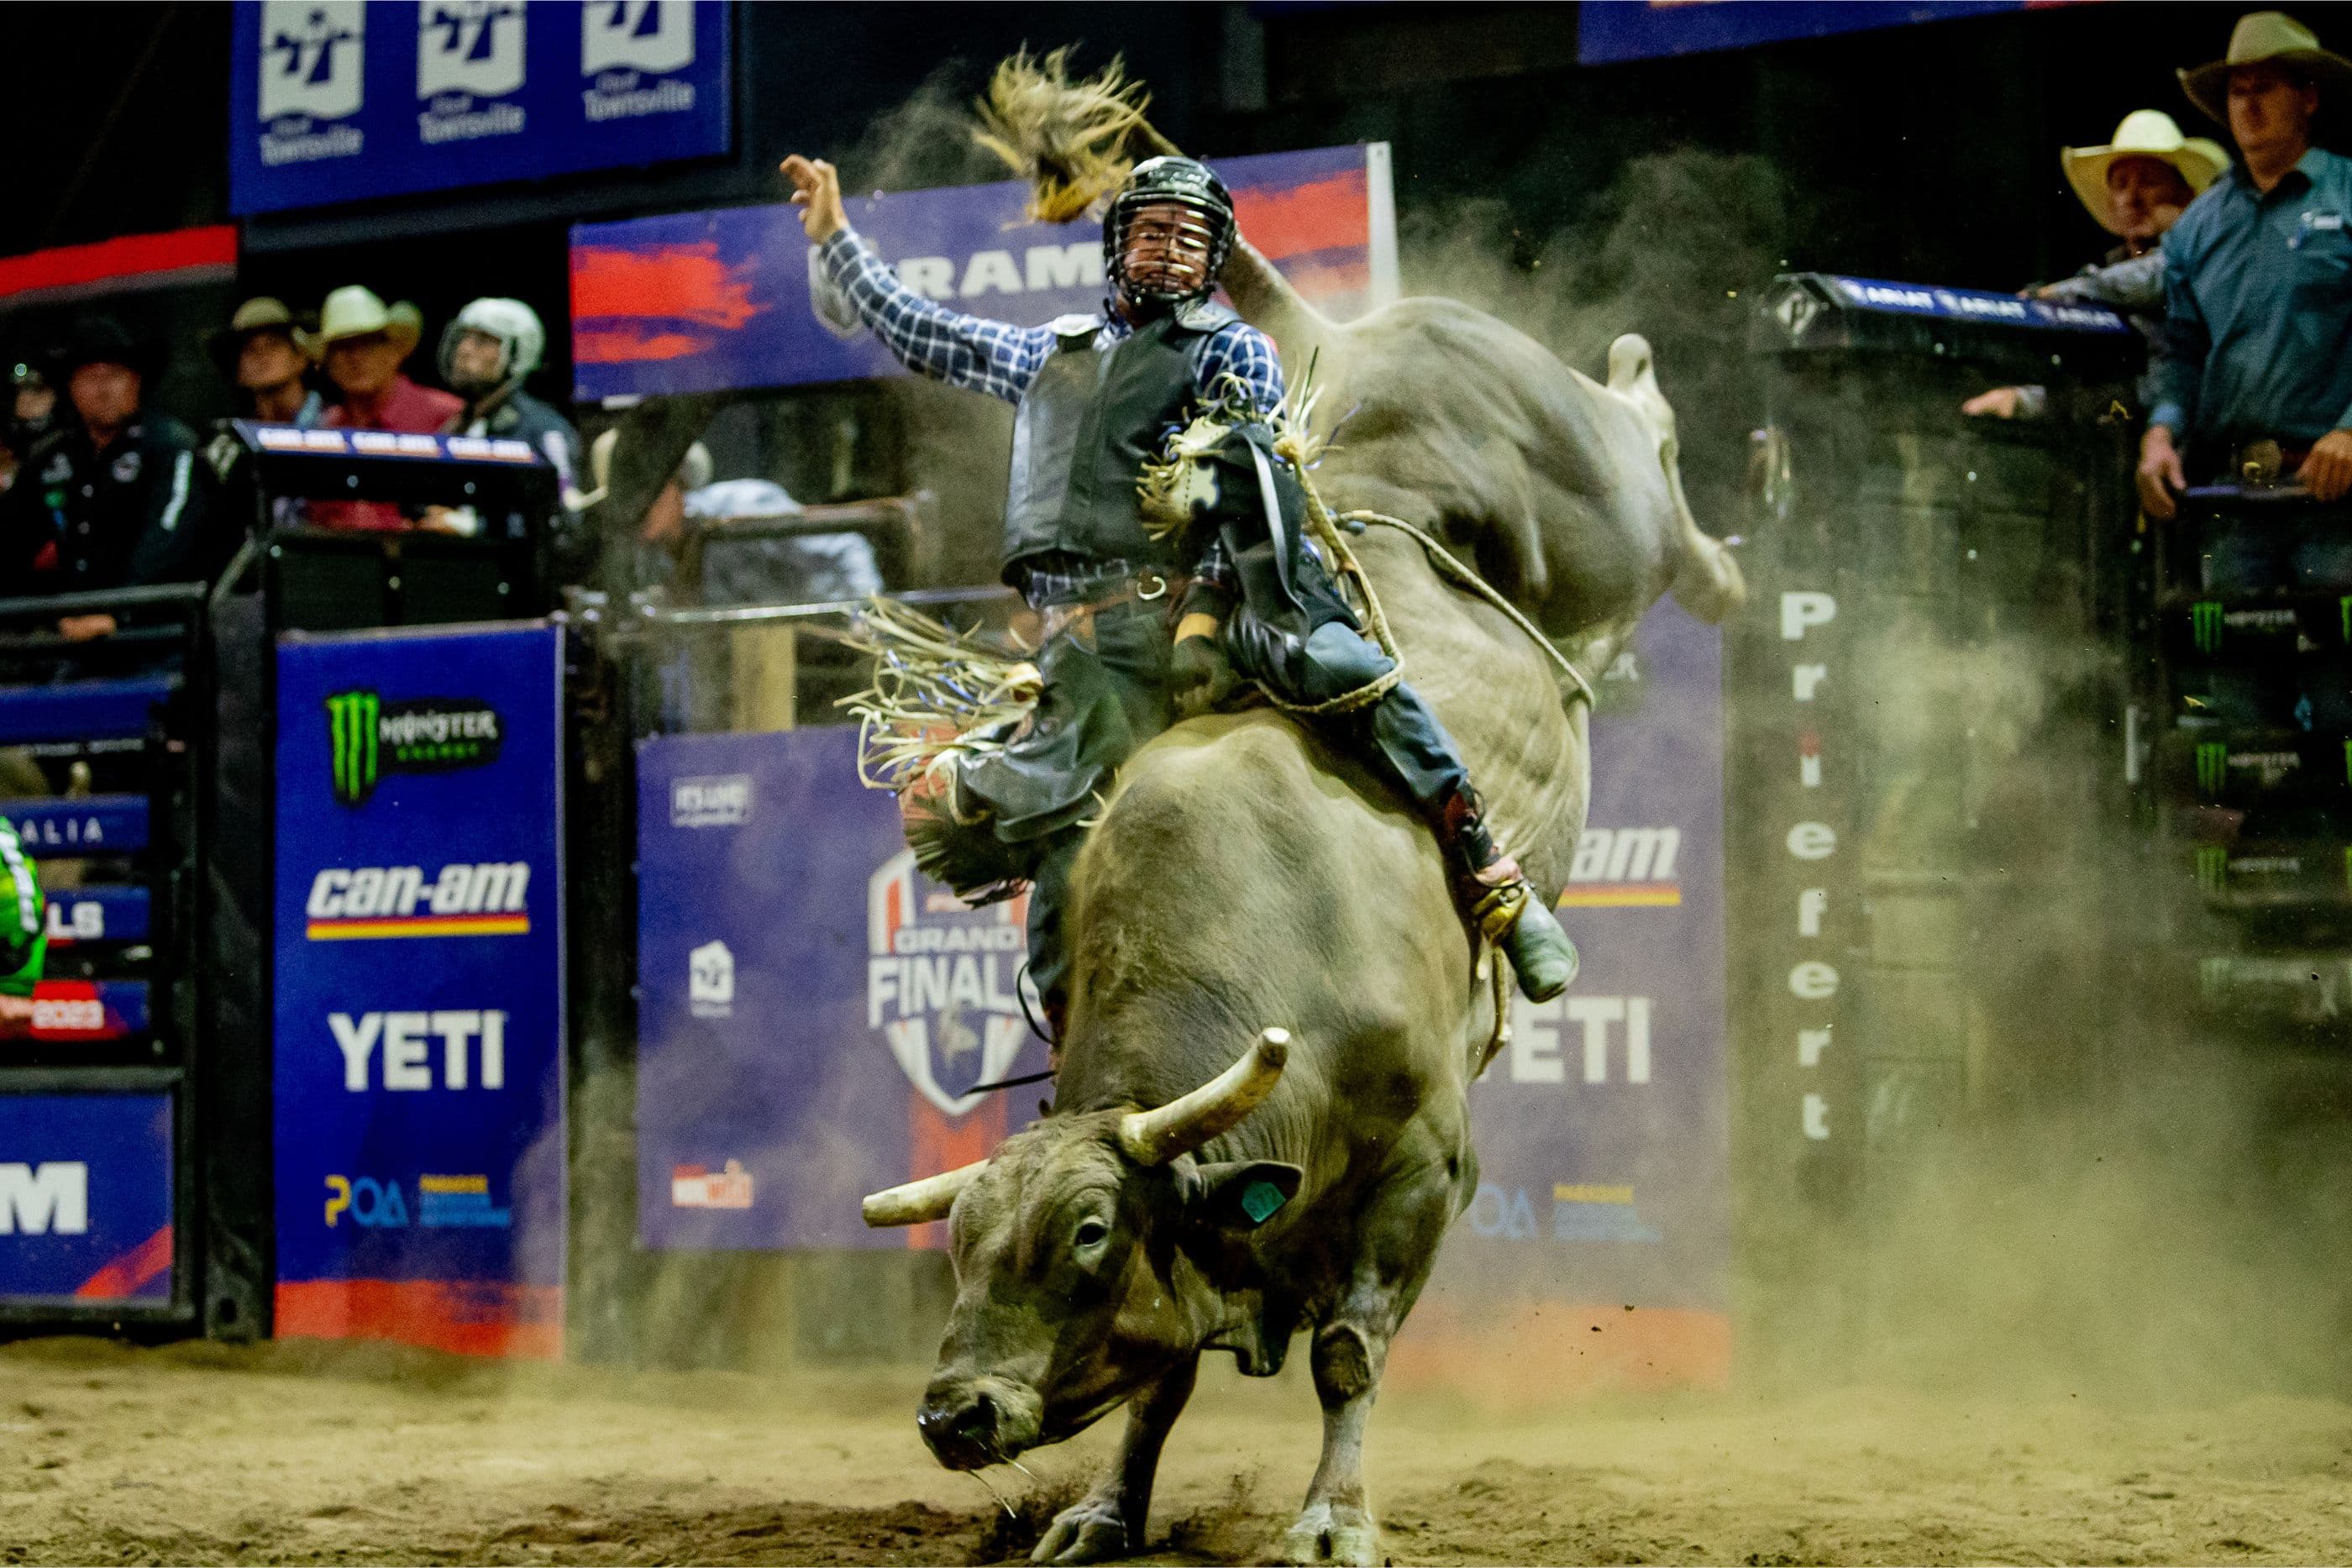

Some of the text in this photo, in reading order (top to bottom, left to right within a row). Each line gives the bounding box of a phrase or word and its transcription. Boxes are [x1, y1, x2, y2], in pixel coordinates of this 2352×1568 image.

[898, 241, 1105, 301] RAM
[379, 709, 498, 746] MONSTER
[20, 816, 103, 845] ALIA
[306, 861, 531, 918] can-am
[1780, 590, 1840, 1141] Priefert
[45, 900, 105, 939] LS
[894, 926, 1021, 955] GRAND
[327, 1009, 506, 1092] YETI
[1480, 994, 1651, 1083] ETI
